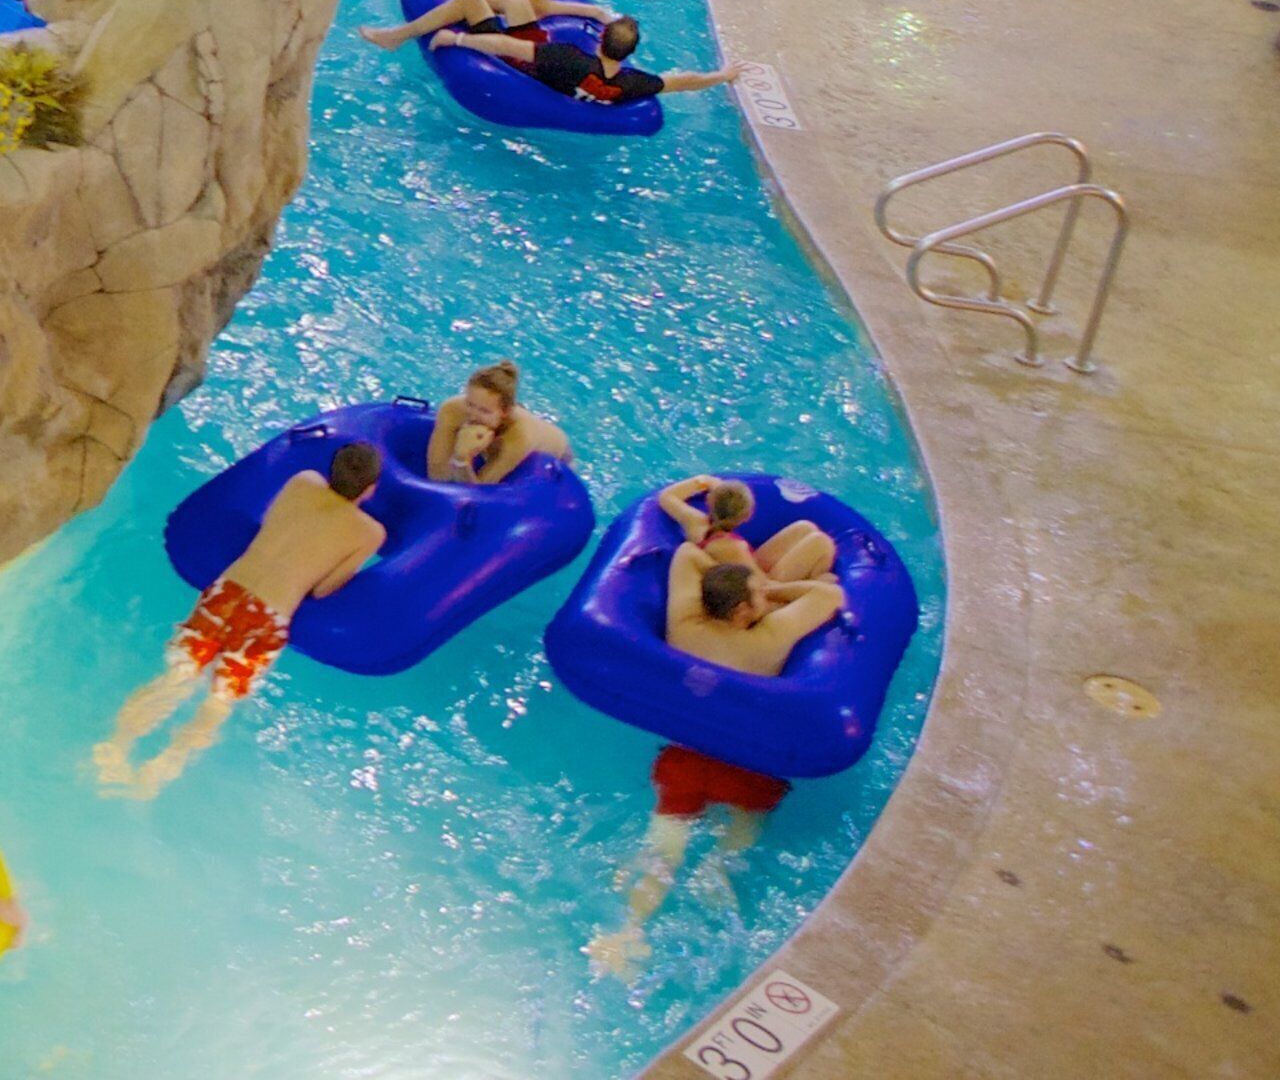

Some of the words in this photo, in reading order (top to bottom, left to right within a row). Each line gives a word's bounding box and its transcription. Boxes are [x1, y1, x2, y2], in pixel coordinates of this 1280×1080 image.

[743, 1001, 768, 1020] IN
[711, 1030, 735, 1050] FT
[731, 1017, 783, 1053] 0
[697, 1044, 752, 1080] 3
